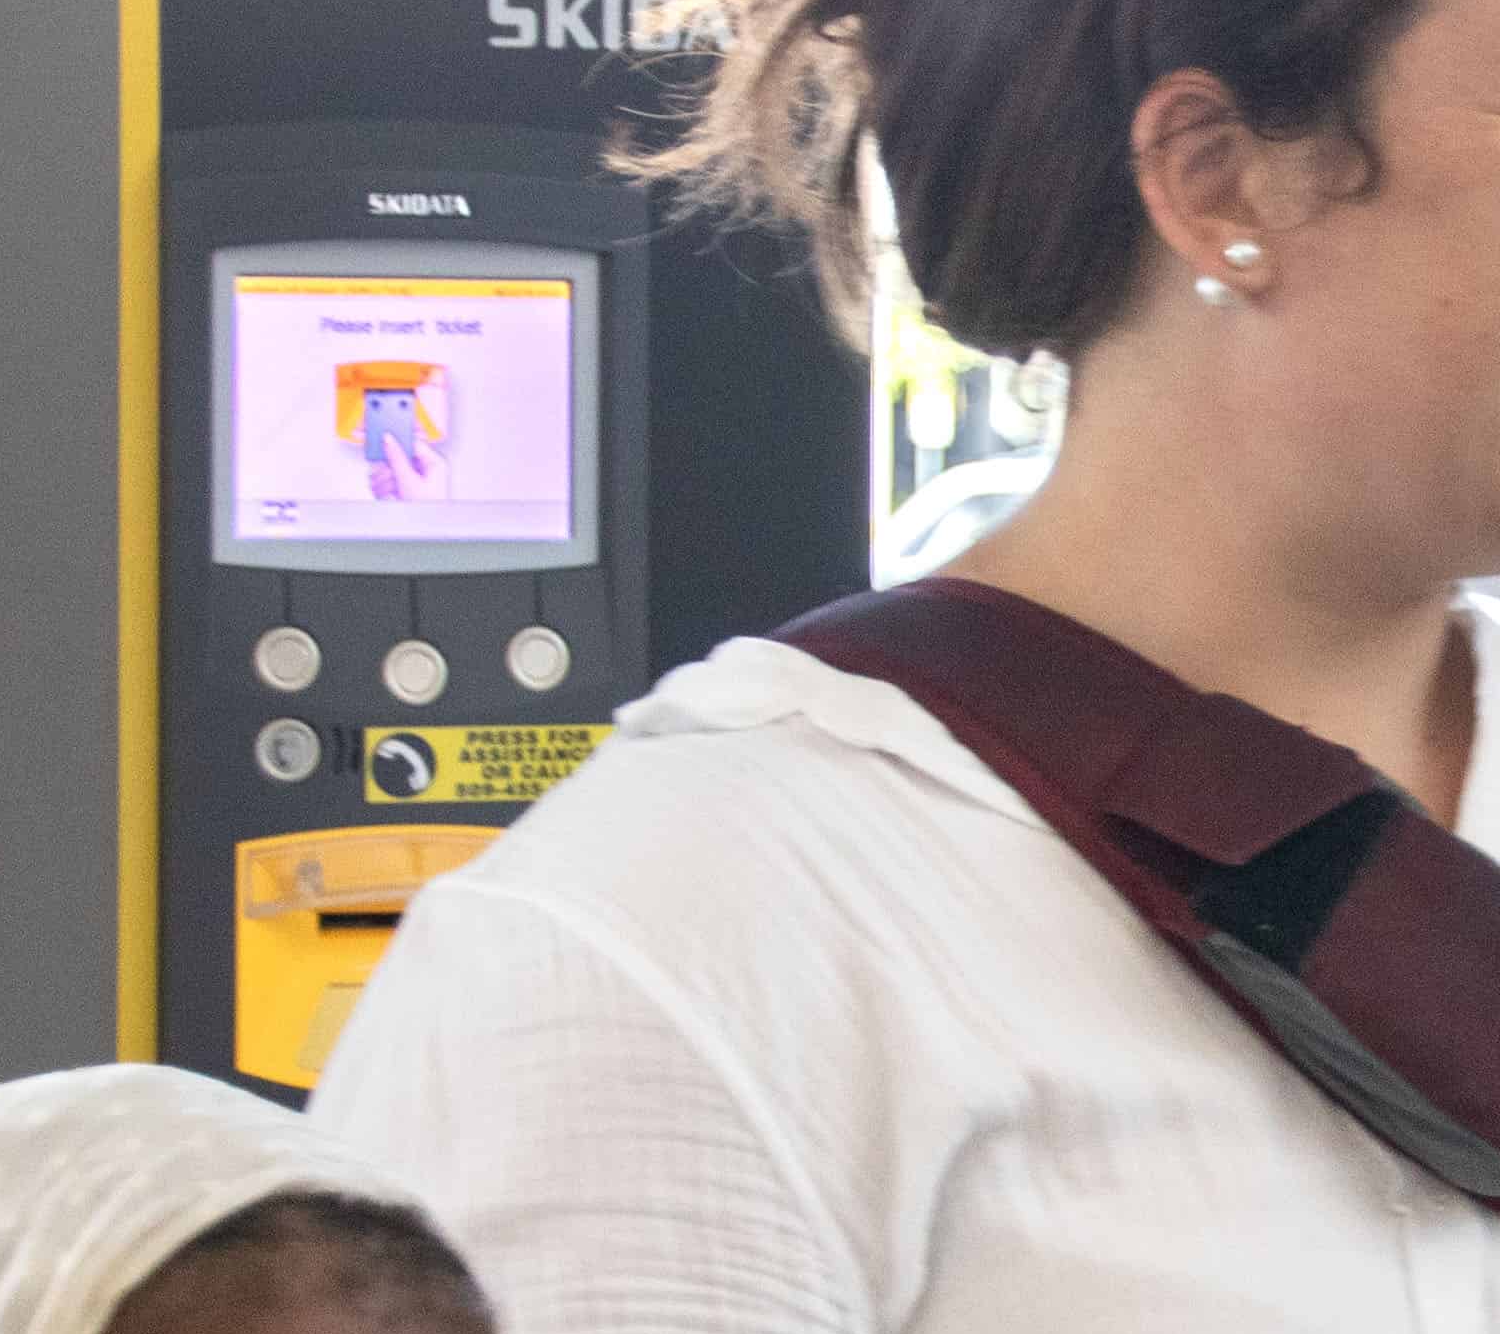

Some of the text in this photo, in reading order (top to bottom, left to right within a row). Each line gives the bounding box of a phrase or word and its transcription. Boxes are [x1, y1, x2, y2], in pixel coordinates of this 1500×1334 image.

[368, 193, 471, 217] SKIDATA
[320, 317, 483, 335] Please insert ticket
[467, 730, 590, 745] PRESS FOR
[482, 764, 511, 780] OR
